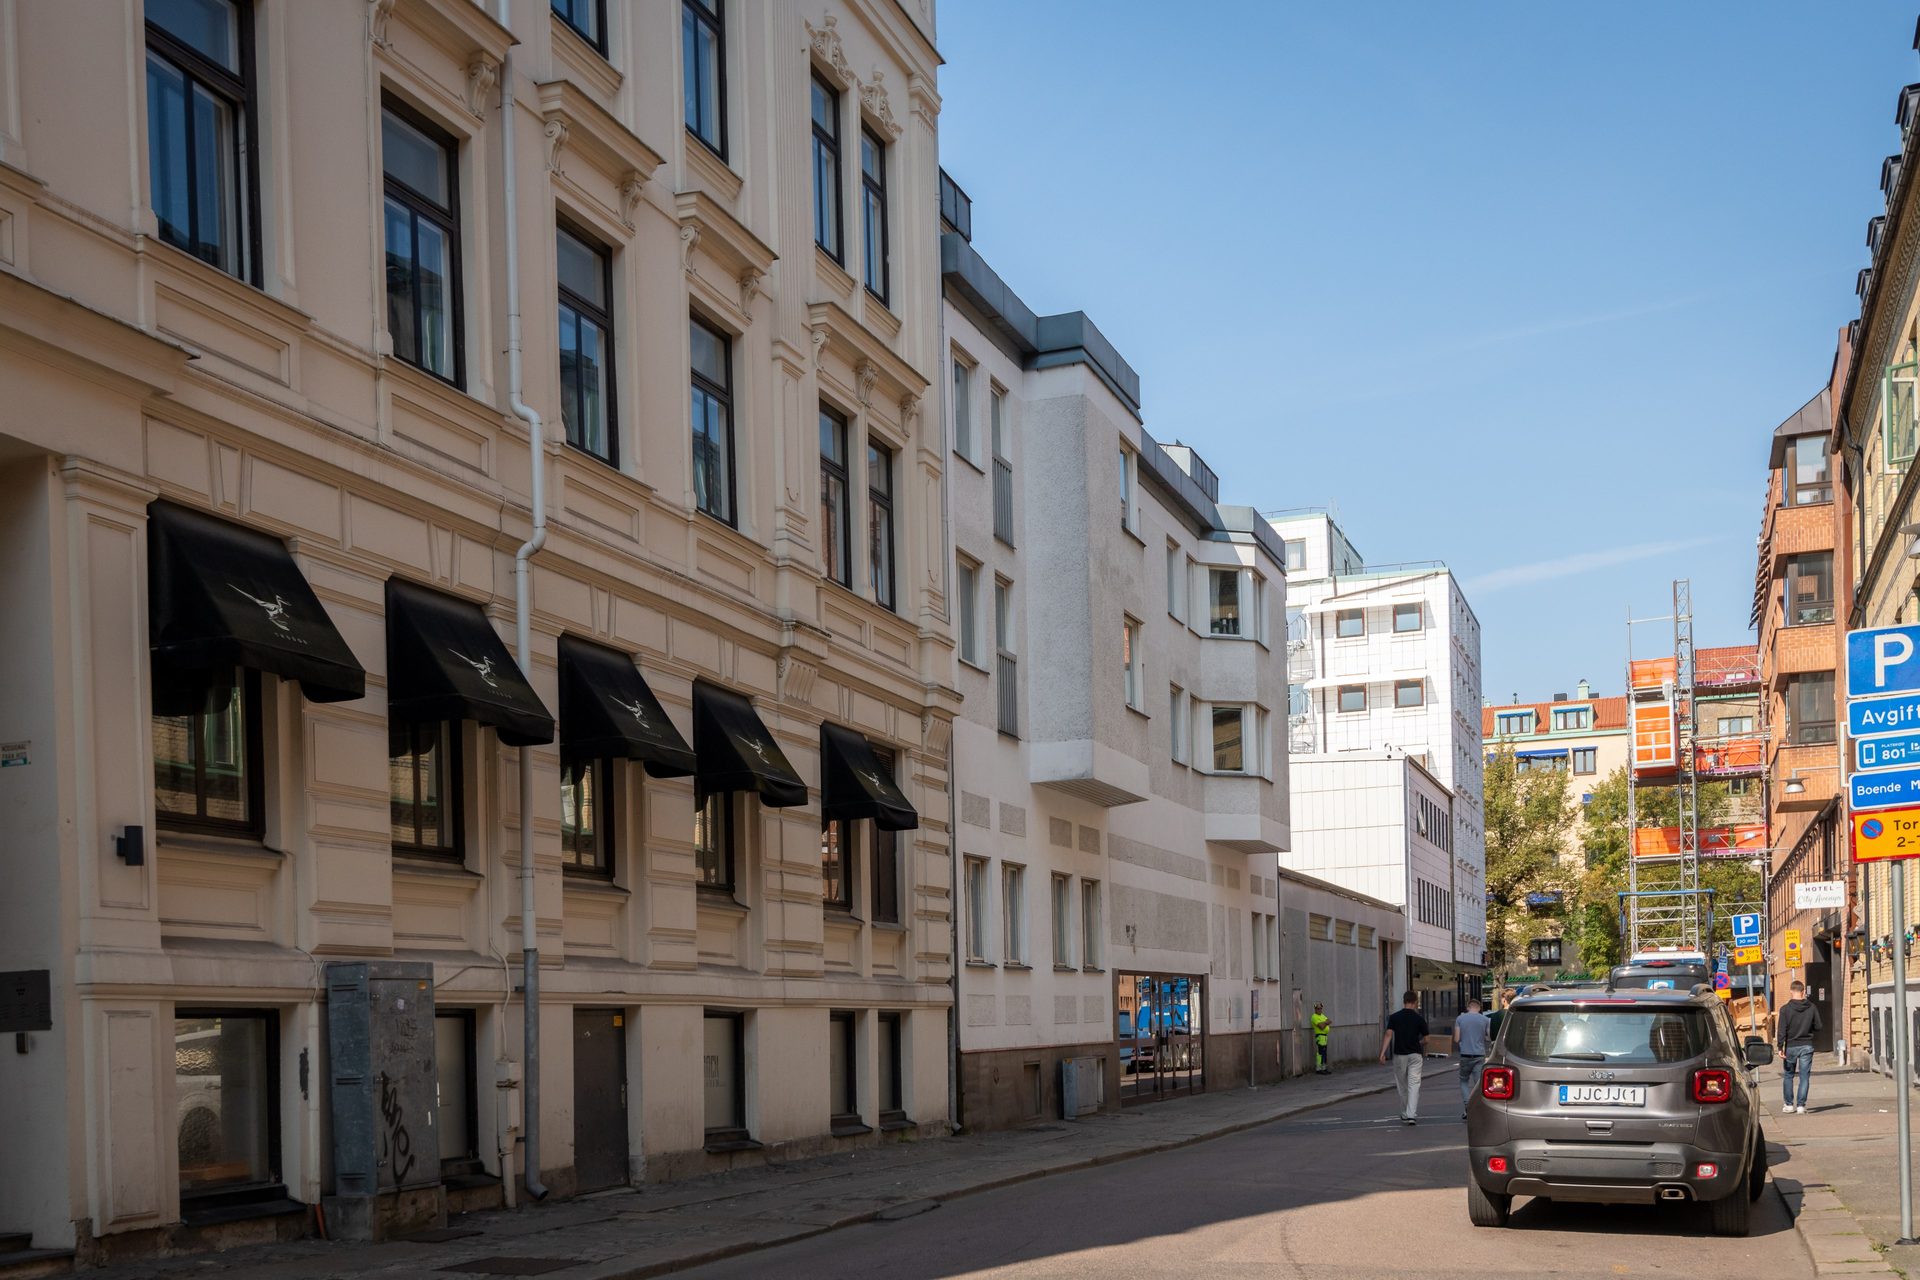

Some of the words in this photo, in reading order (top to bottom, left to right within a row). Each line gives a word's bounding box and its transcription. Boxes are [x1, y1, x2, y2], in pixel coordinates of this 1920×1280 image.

[1875, 633, 1914, 687] P
[1882, 748, 1906, 760] 801
[1856, 782, 1901, 796] Boende
[1740, 916, 1754, 934] P
